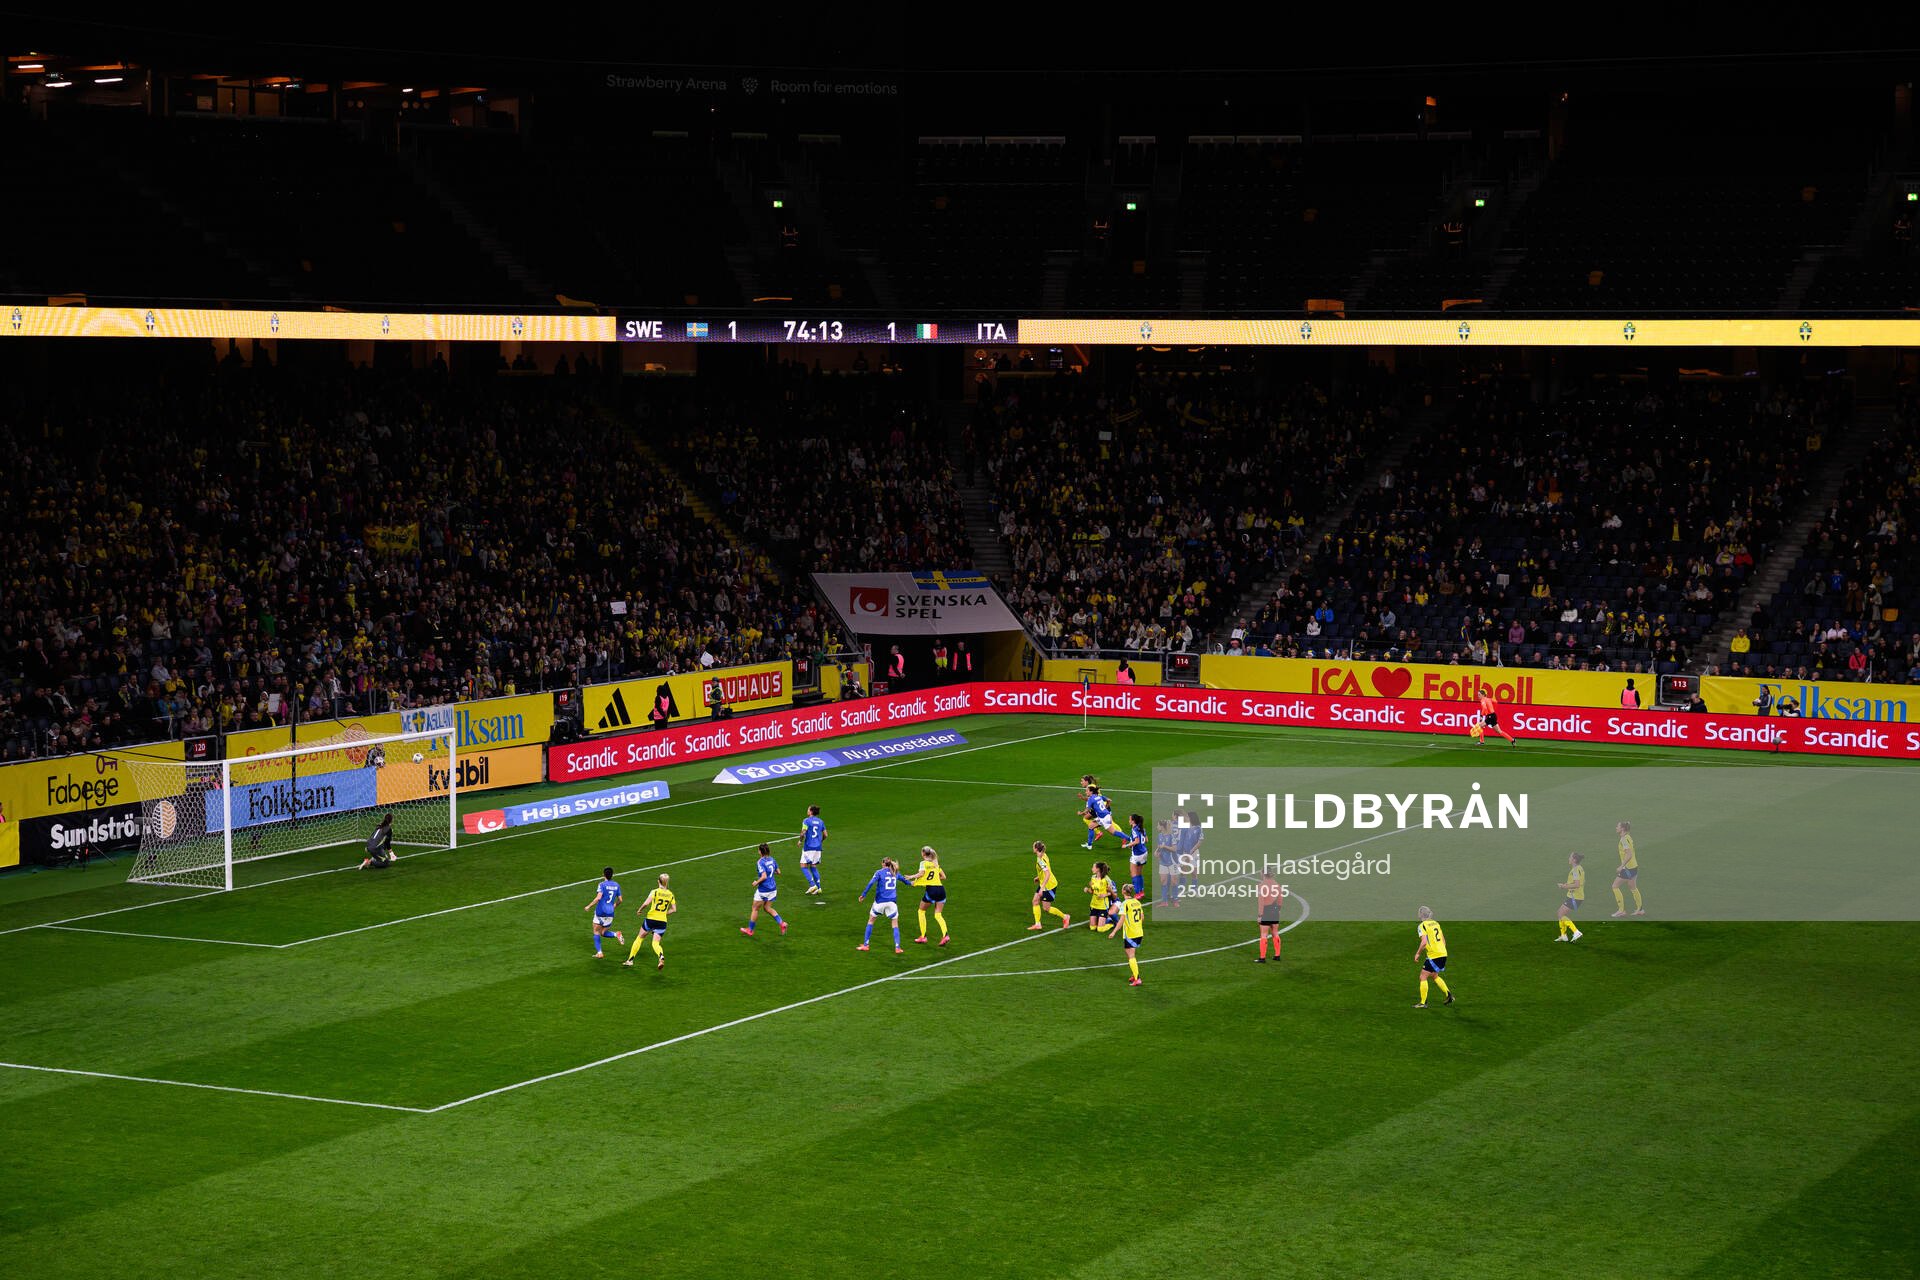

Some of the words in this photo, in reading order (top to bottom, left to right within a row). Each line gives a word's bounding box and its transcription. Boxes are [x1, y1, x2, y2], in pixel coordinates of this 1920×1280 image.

[606, 74, 682, 92] Strawberry
[686, 77, 727, 91] Arena
[771, 79, 810, 93] Room
[813, 79, 832, 93] for
[834, 80, 897, 95] emotions
[625, 321, 663, 338] SWE
[727, 321, 738, 339] 1
[783, 321, 844, 340] 74:13
[886, 322, 897, 340] 1
[977, 323, 1008, 339] ITA
[896, 594, 987, 606] SVENSKA
[896, 607, 942, 619] SPEL
[1312, 668, 1364, 696] ICA
[1424, 673, 1533, 704] Fotboll
[1673, 680, 1687, 688] 113
[567, 746, 618, 773] Scandic
[627, 737, 676, 764] Scandic
[685, 729, 731, 754] Scandic
[739, 720, 783, 745] Scandic
[791, 712, 833, 736] Scandic
[840, 704, 881, 728] Scandic
[888, 696, 927, 720] Scandic
[933, 688, 971, 713] Scandic
[984, 688, 1057, 707] Scandic
[1071, 690, 1141, 710] Scandic
[1155, 694, 1227, 715] Scandic
[1241, 699, 1315, 719] Scandic
[1330, 703, 1405, 724] Scandic
[1512, 712, 1591, 734] Scandic
[1607, 717, 1688, 739] Scandic
[1704, 722, 1787, 744] Scandic
[1804, 727, 1889, 750] Scandic
[194, 743, 206, 751] 120
[768, 757, 827, 774] OBOS
[842, 746, 880, 761] Nya
[882, 732, 956, 754] bostäder
[47, 773, 119, 806] Fabege
[249, 785, 335, 820] Folksam
[522, 803, 571, 822] Heja
[574, 786, 660, 811] Sverige!
[811, 825, 819, 839] 5
[884, 876, 897, 890] 23
[926, 870, 935, 881] 8
[606, 890, 614, 904] 3
[655, 898, 670, 912] 23
[1433, 927, 1441, 942] 2
